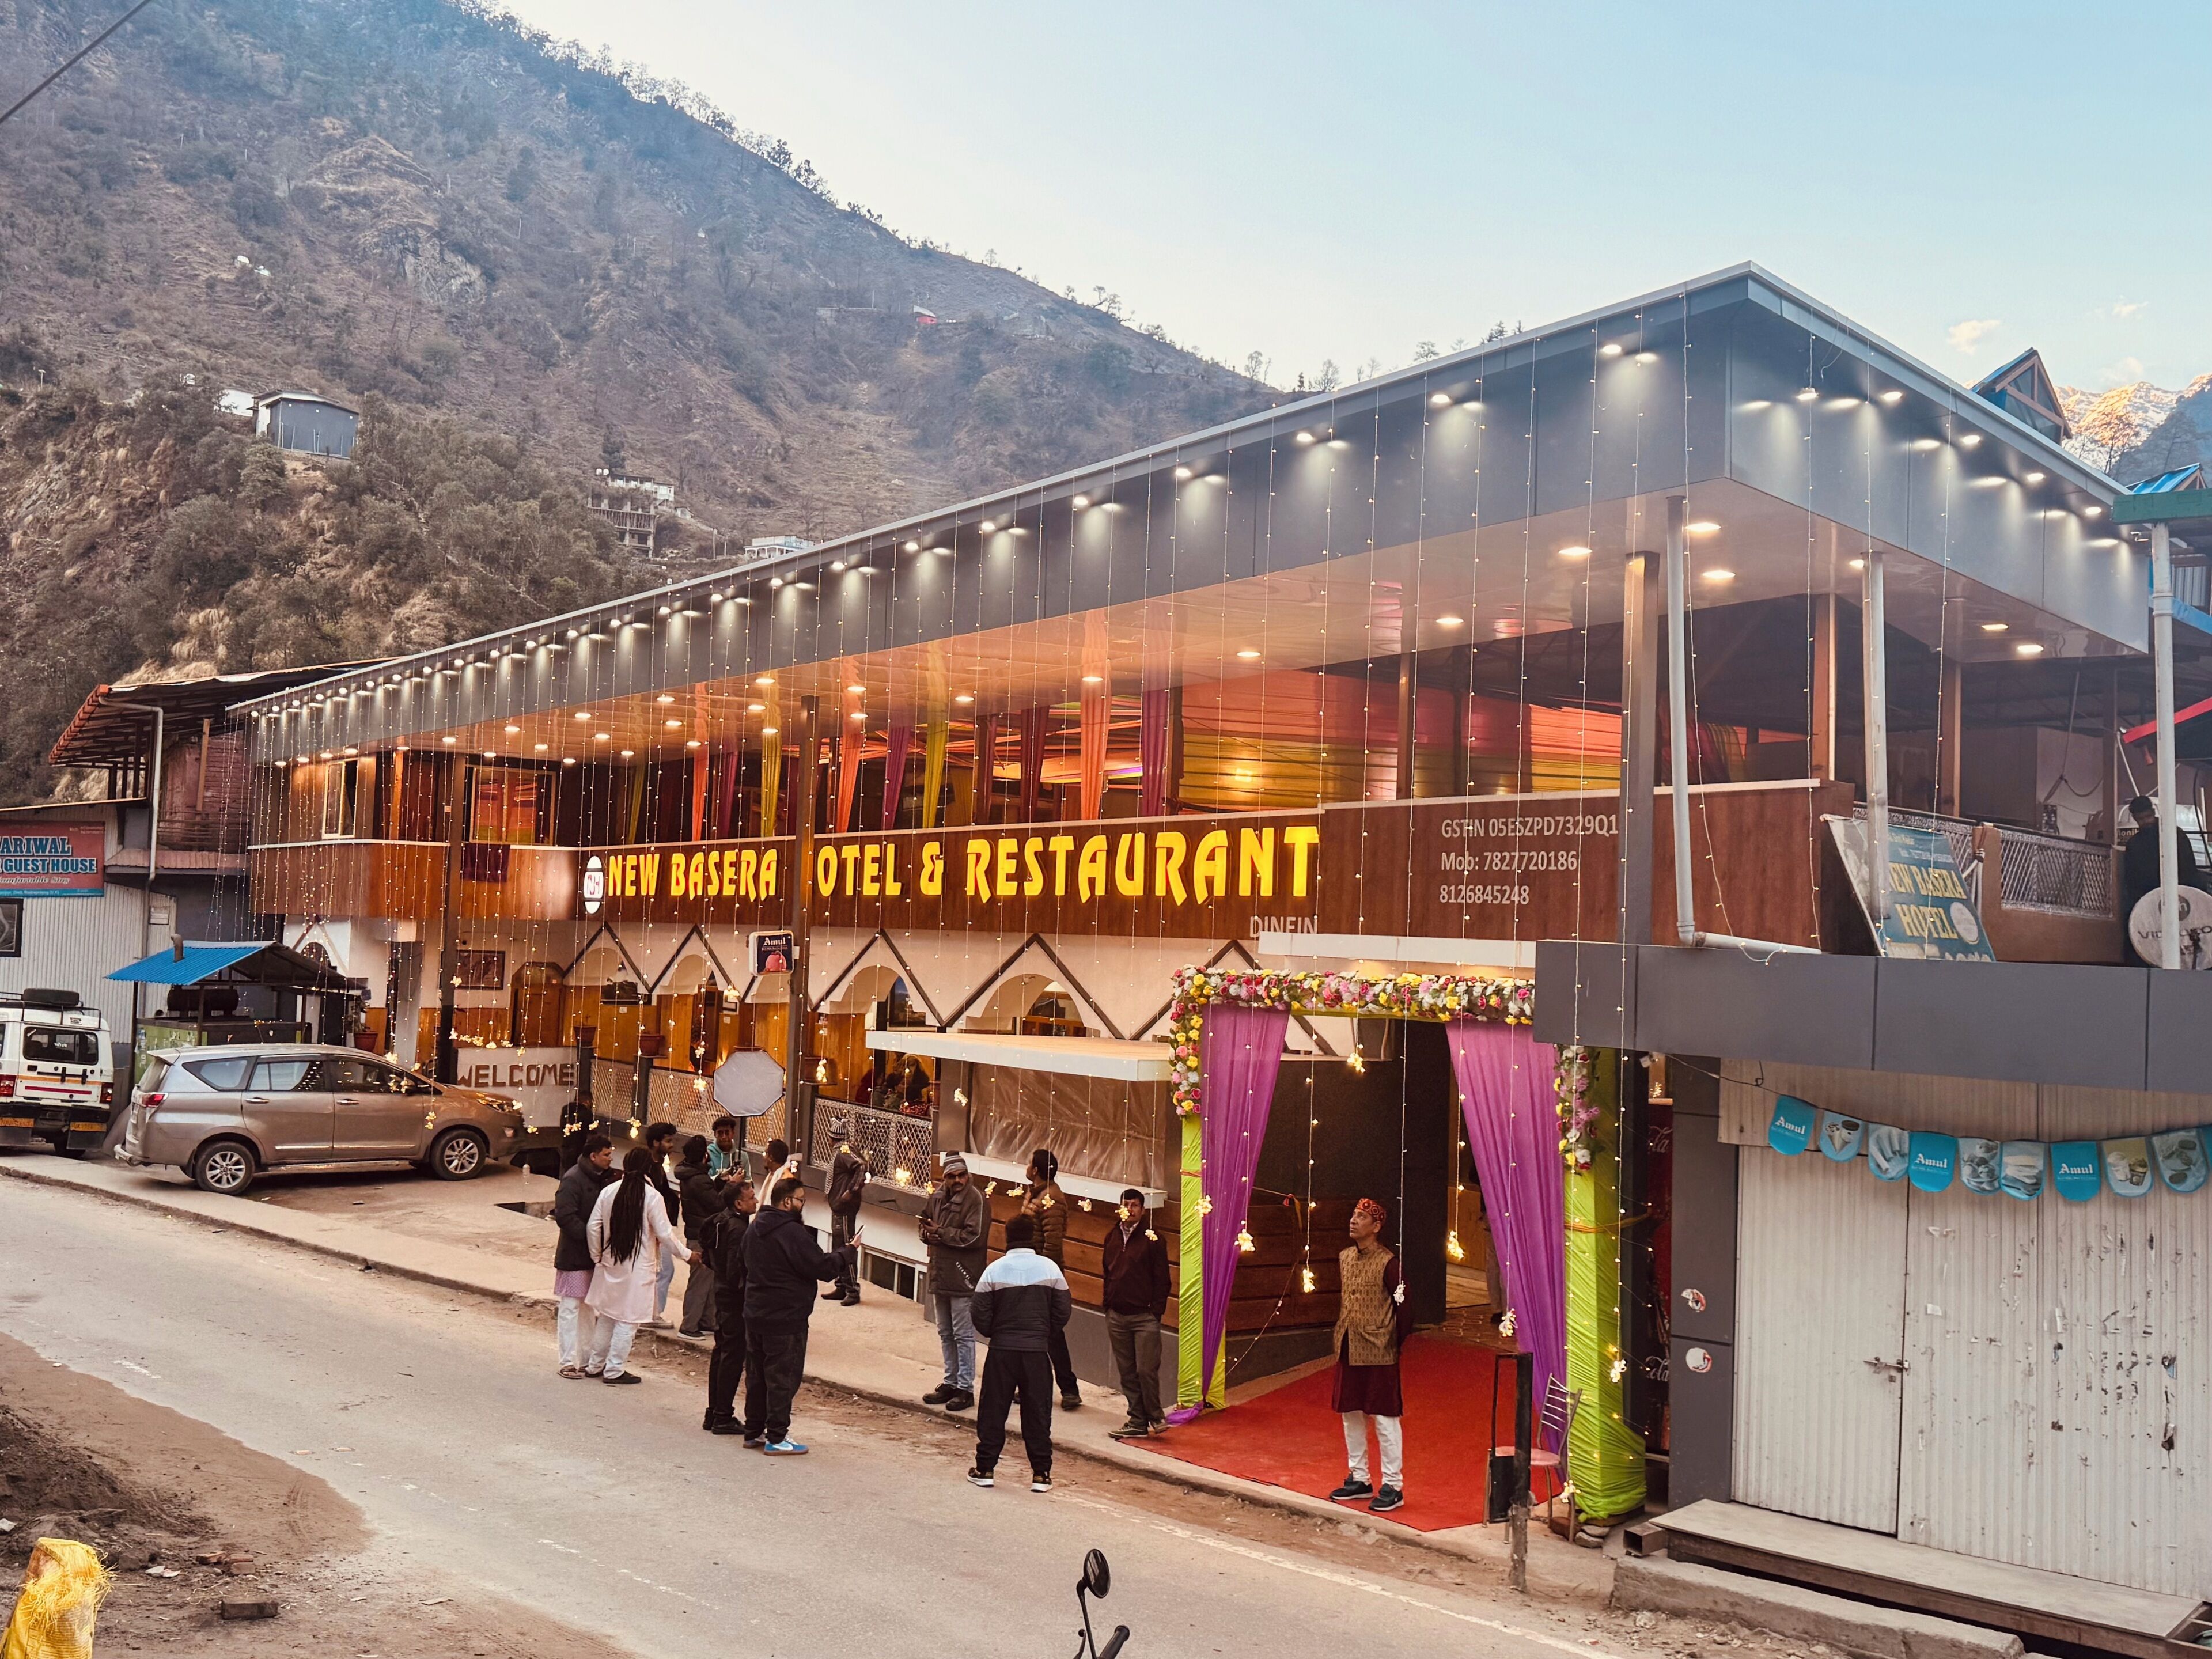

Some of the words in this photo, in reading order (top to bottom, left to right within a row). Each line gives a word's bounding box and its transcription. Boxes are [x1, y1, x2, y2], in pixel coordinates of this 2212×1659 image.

[1442, 819, 1484, 838] GSTIN
[3, 857, 49, 873] GUEST
[50, 858, 97, 873] HOUSE
[608, 853, 660, 897] NEW
[671, 849, 778, 902] BASERA
[817, 843, 902, 897] OTEL
[920, 841, 944, 896] &
[967, 825, 1320, 906] RESTAURANT
[1441, 851, 1479, 870] Mob:
[1483, 851, 1577, 870] 7827720186
[1440, 885, 1529, 904] 8126845248
[1895, 903, 1959, 939] HOTEL
[763, 937, 786, 945] Amul
[457, 1063, 574, 1088] WELCOME
[1775, 1116, 1806, 1135] Amul
[1915, 1153, 1948, 1168] Amul
[2059, 1163, 2093, 1175] Amul
